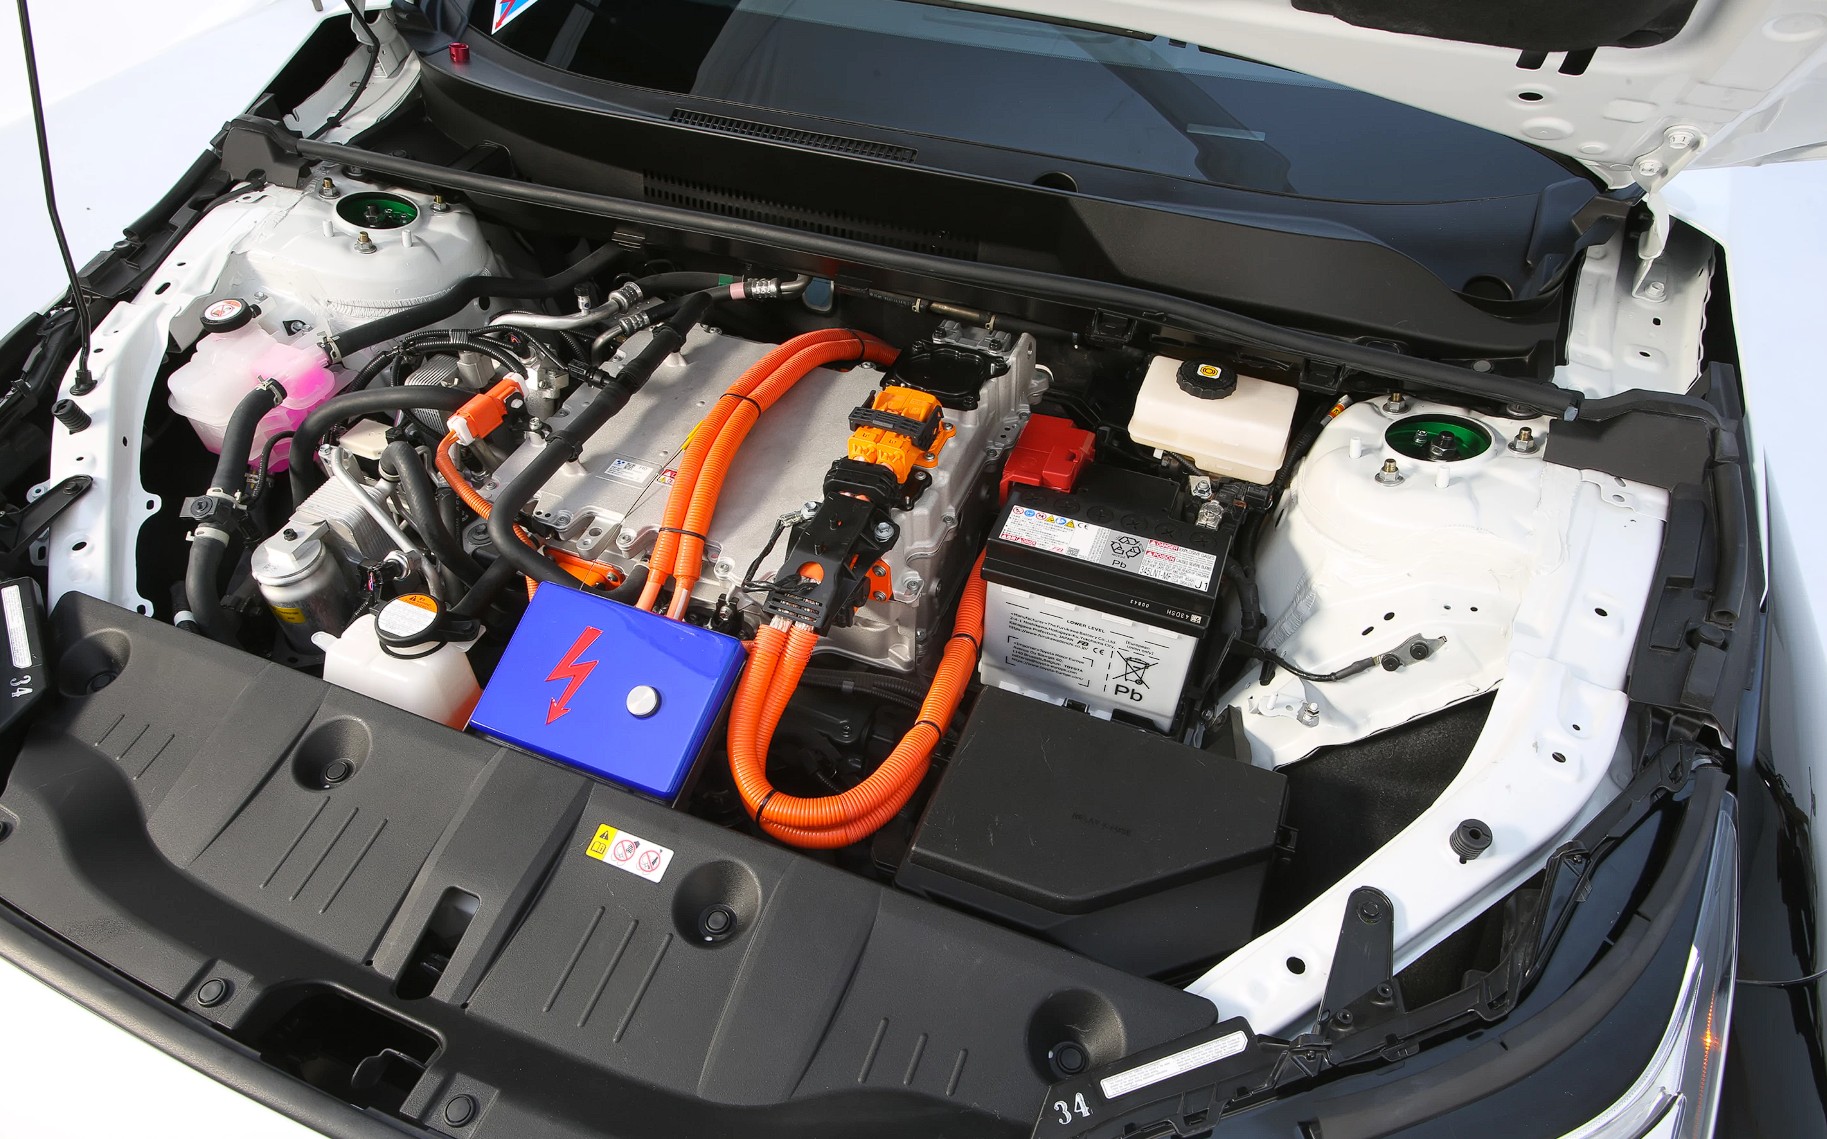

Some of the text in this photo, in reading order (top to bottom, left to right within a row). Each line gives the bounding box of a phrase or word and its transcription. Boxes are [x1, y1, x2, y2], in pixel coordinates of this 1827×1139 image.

[1111, 559, 1127, 569] Pb
[1066, 619, 1105, 634] LOWER LEVEL
[1092, 647, 1105, 656] CE
[1064, 664, 1084, 672] TOYOTA
[9, 674, 34, 699] 34
[1113, 683, 1143, 702] Pb
[1053, 1092, 1092, 1126] 34
